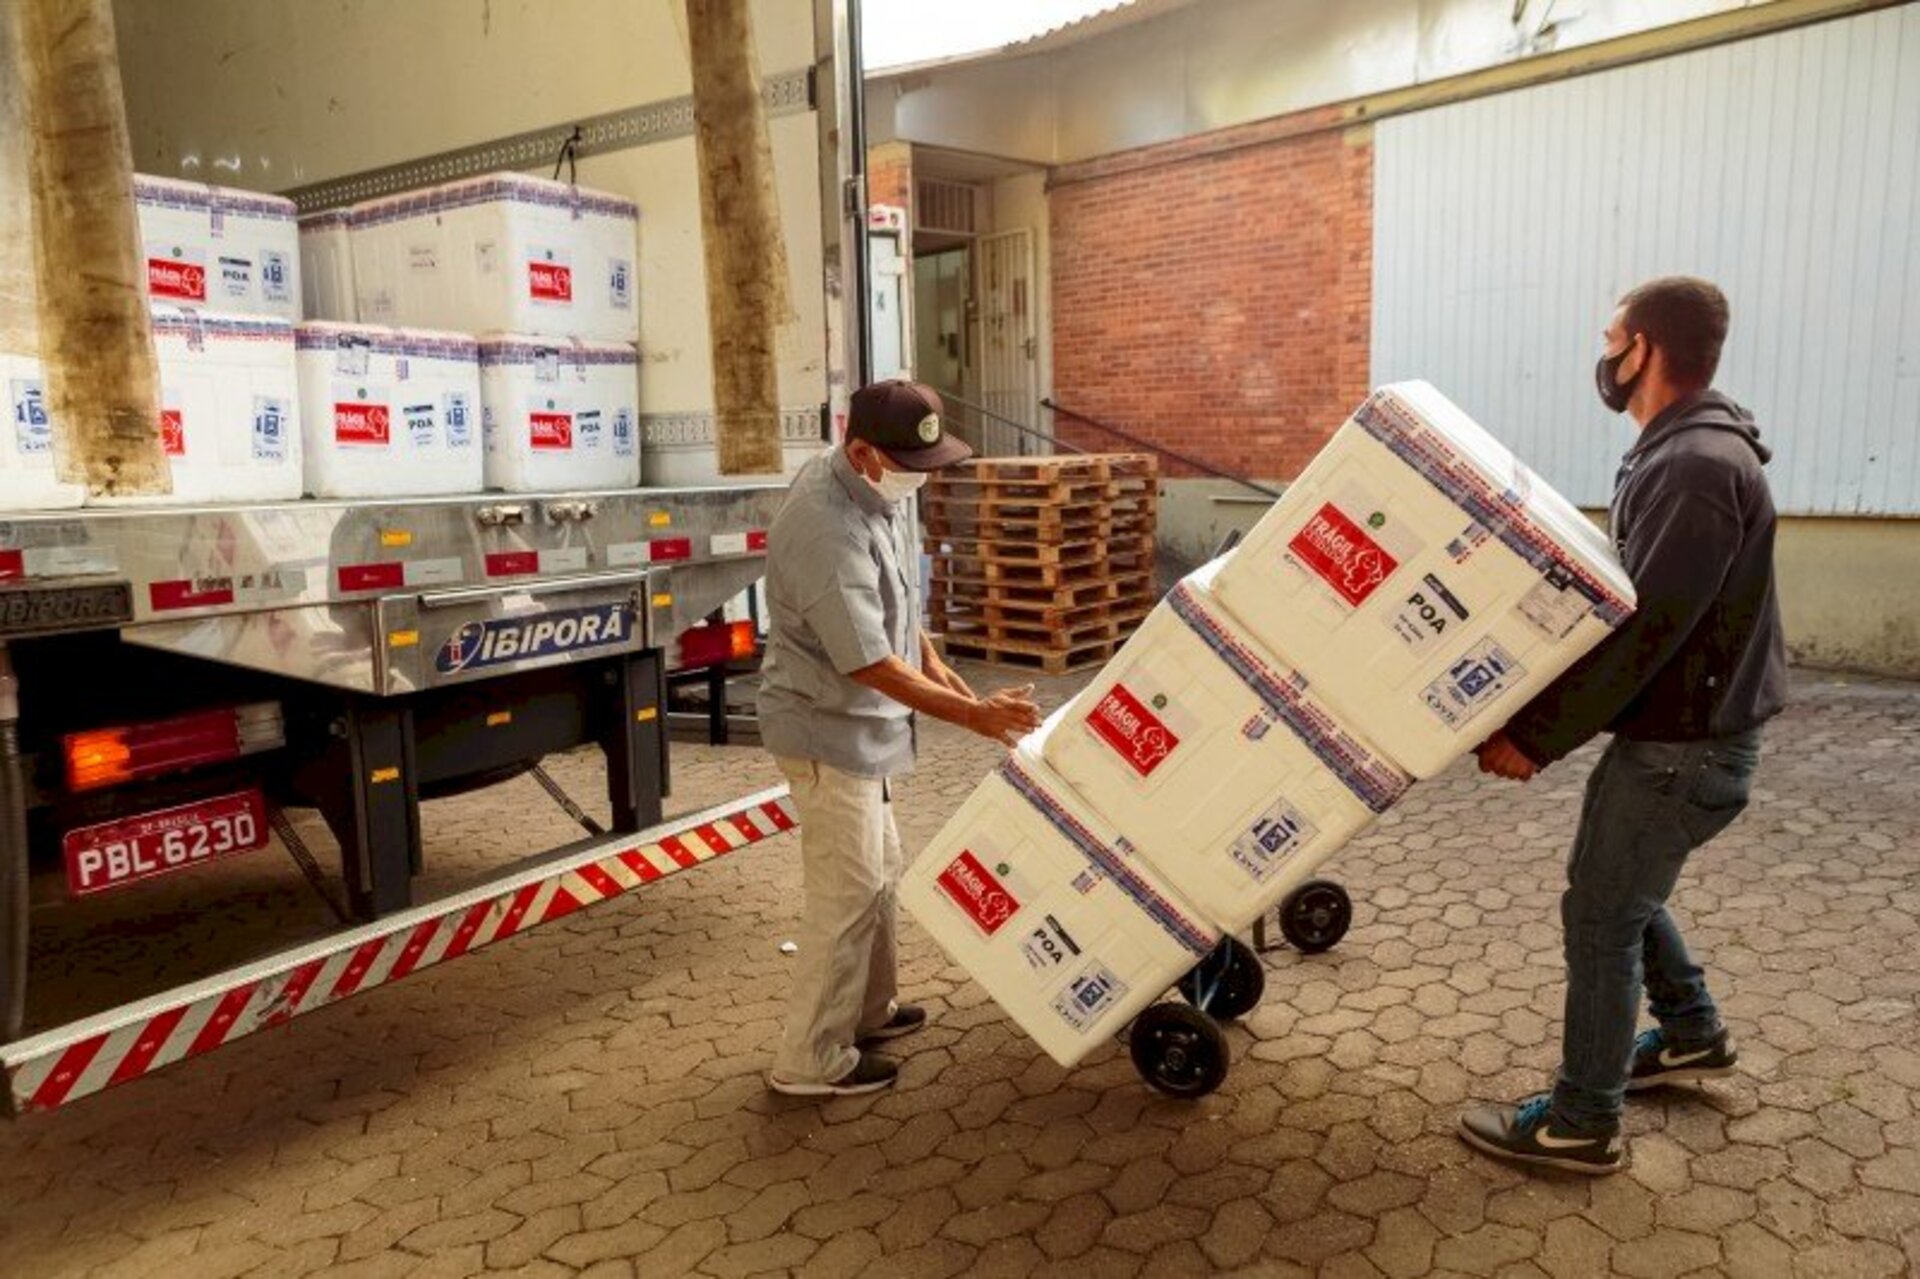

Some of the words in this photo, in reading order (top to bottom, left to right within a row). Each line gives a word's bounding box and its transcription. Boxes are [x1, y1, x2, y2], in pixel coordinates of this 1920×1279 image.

[1308, 515, 1354, 562] FRÁGIL
[481, 605, 622, 661] IBIPORÃ
[1408, 592, 1446, 634] POA
[1103, 694, 1141, 737] FRÁGIL
[1033, 929, 1064, 964] POA
